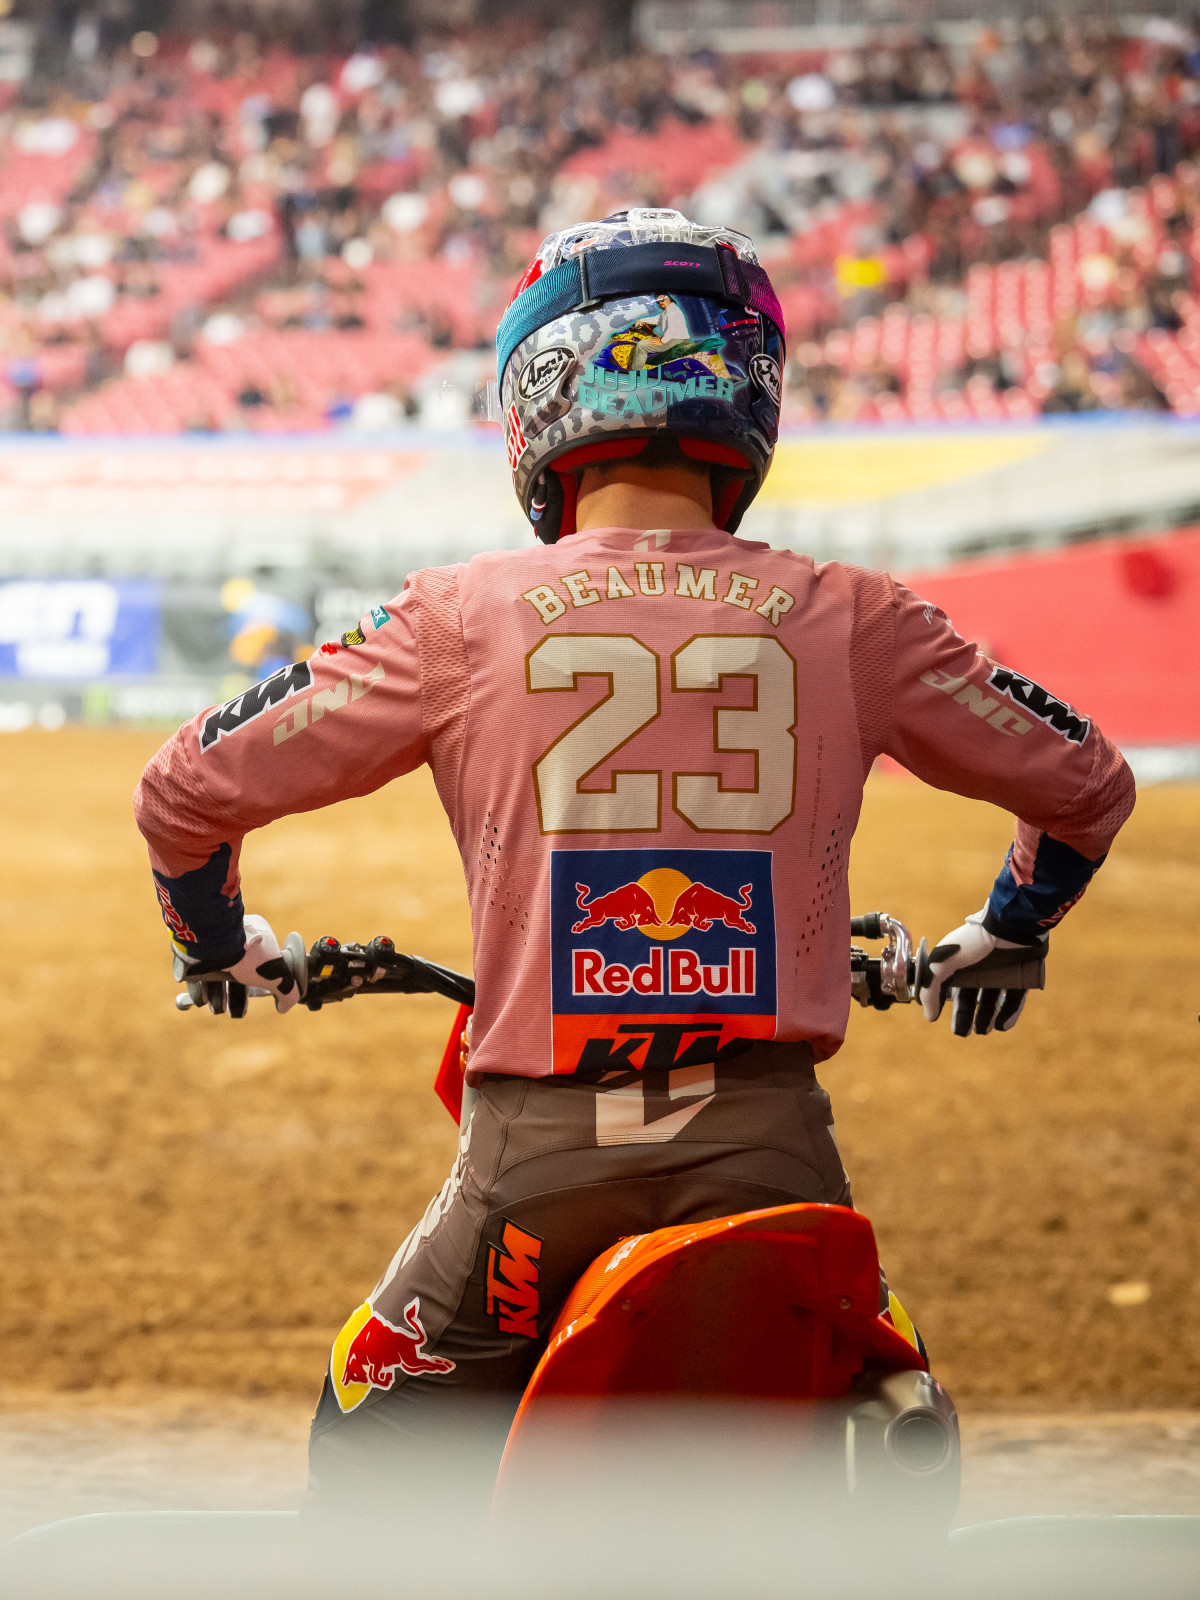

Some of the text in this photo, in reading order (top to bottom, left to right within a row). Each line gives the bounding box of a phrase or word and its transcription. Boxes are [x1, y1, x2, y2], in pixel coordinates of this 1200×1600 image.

[663, 260, 702, 268] SCOTT
[577, 375, 735, 416] BEAUMER
[578, 362, 662, 392] JUJU
[520, 561, 796, 628] BEAUMER
[524, 632, 799, 836] 23
[985, 664, 1091, 747] KTM
[571, 946, 757, 997] Red Bull
[485, 1220, 543, 1339] KTM
